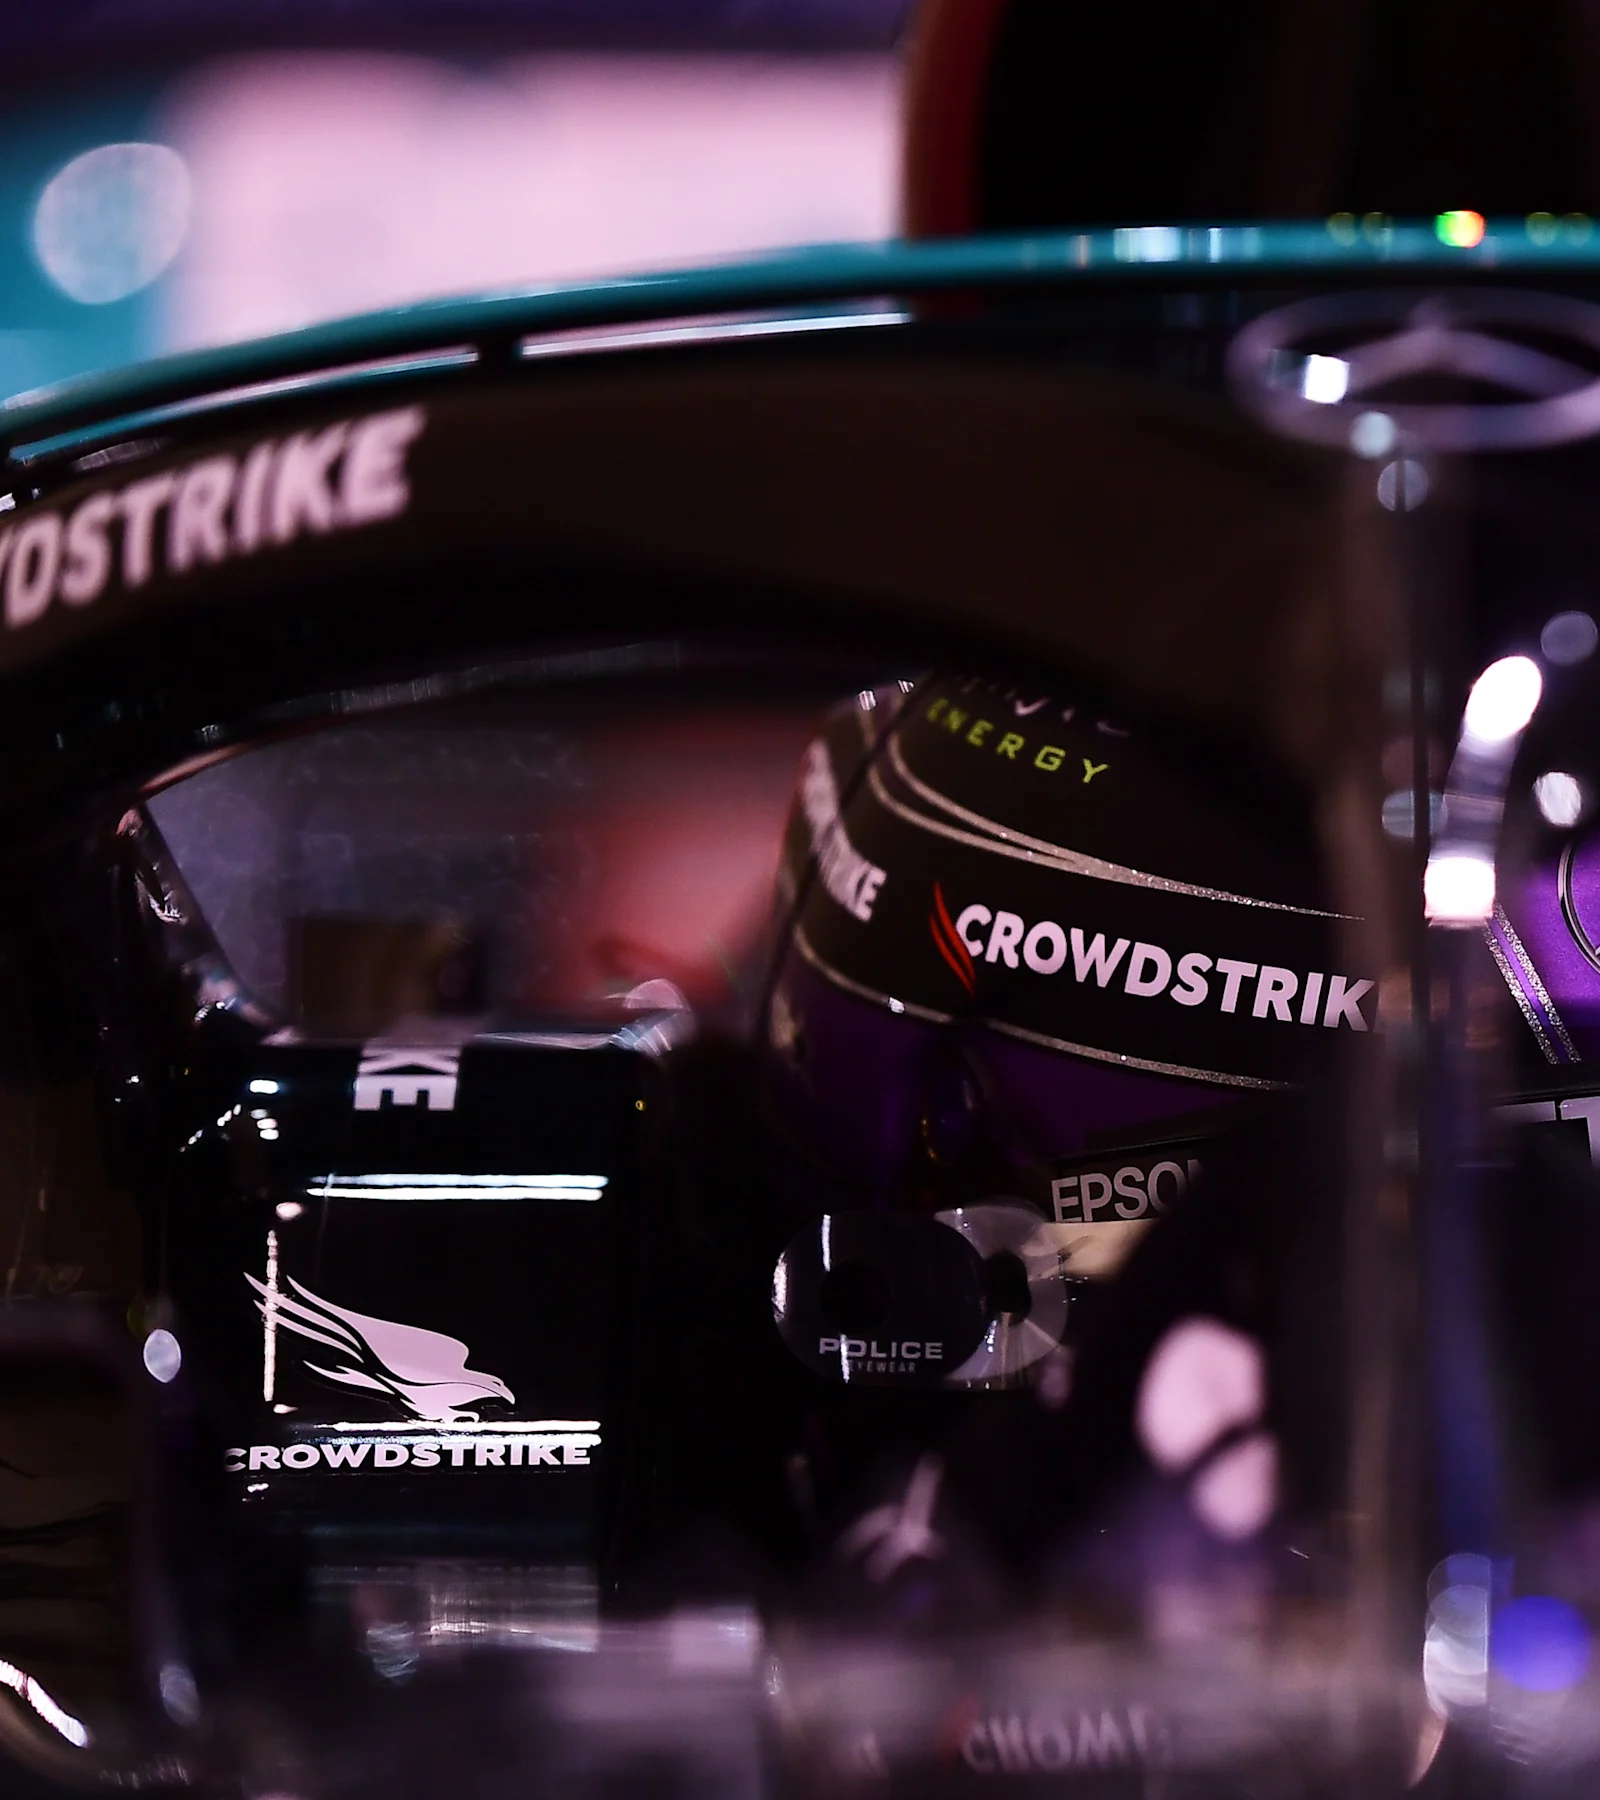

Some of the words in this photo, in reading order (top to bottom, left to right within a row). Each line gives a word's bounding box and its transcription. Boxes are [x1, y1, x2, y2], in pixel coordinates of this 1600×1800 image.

[0, 402, 426, 627] DSTRIKE
[955, 903, 1385, 1033] CROWDSTRIK
[1051, 1158, 1202, 1223] EPSO
[819, 1337, 943, 1359] POLICE
[224, 1443, 591, 1471] CROWDSTRIKE
